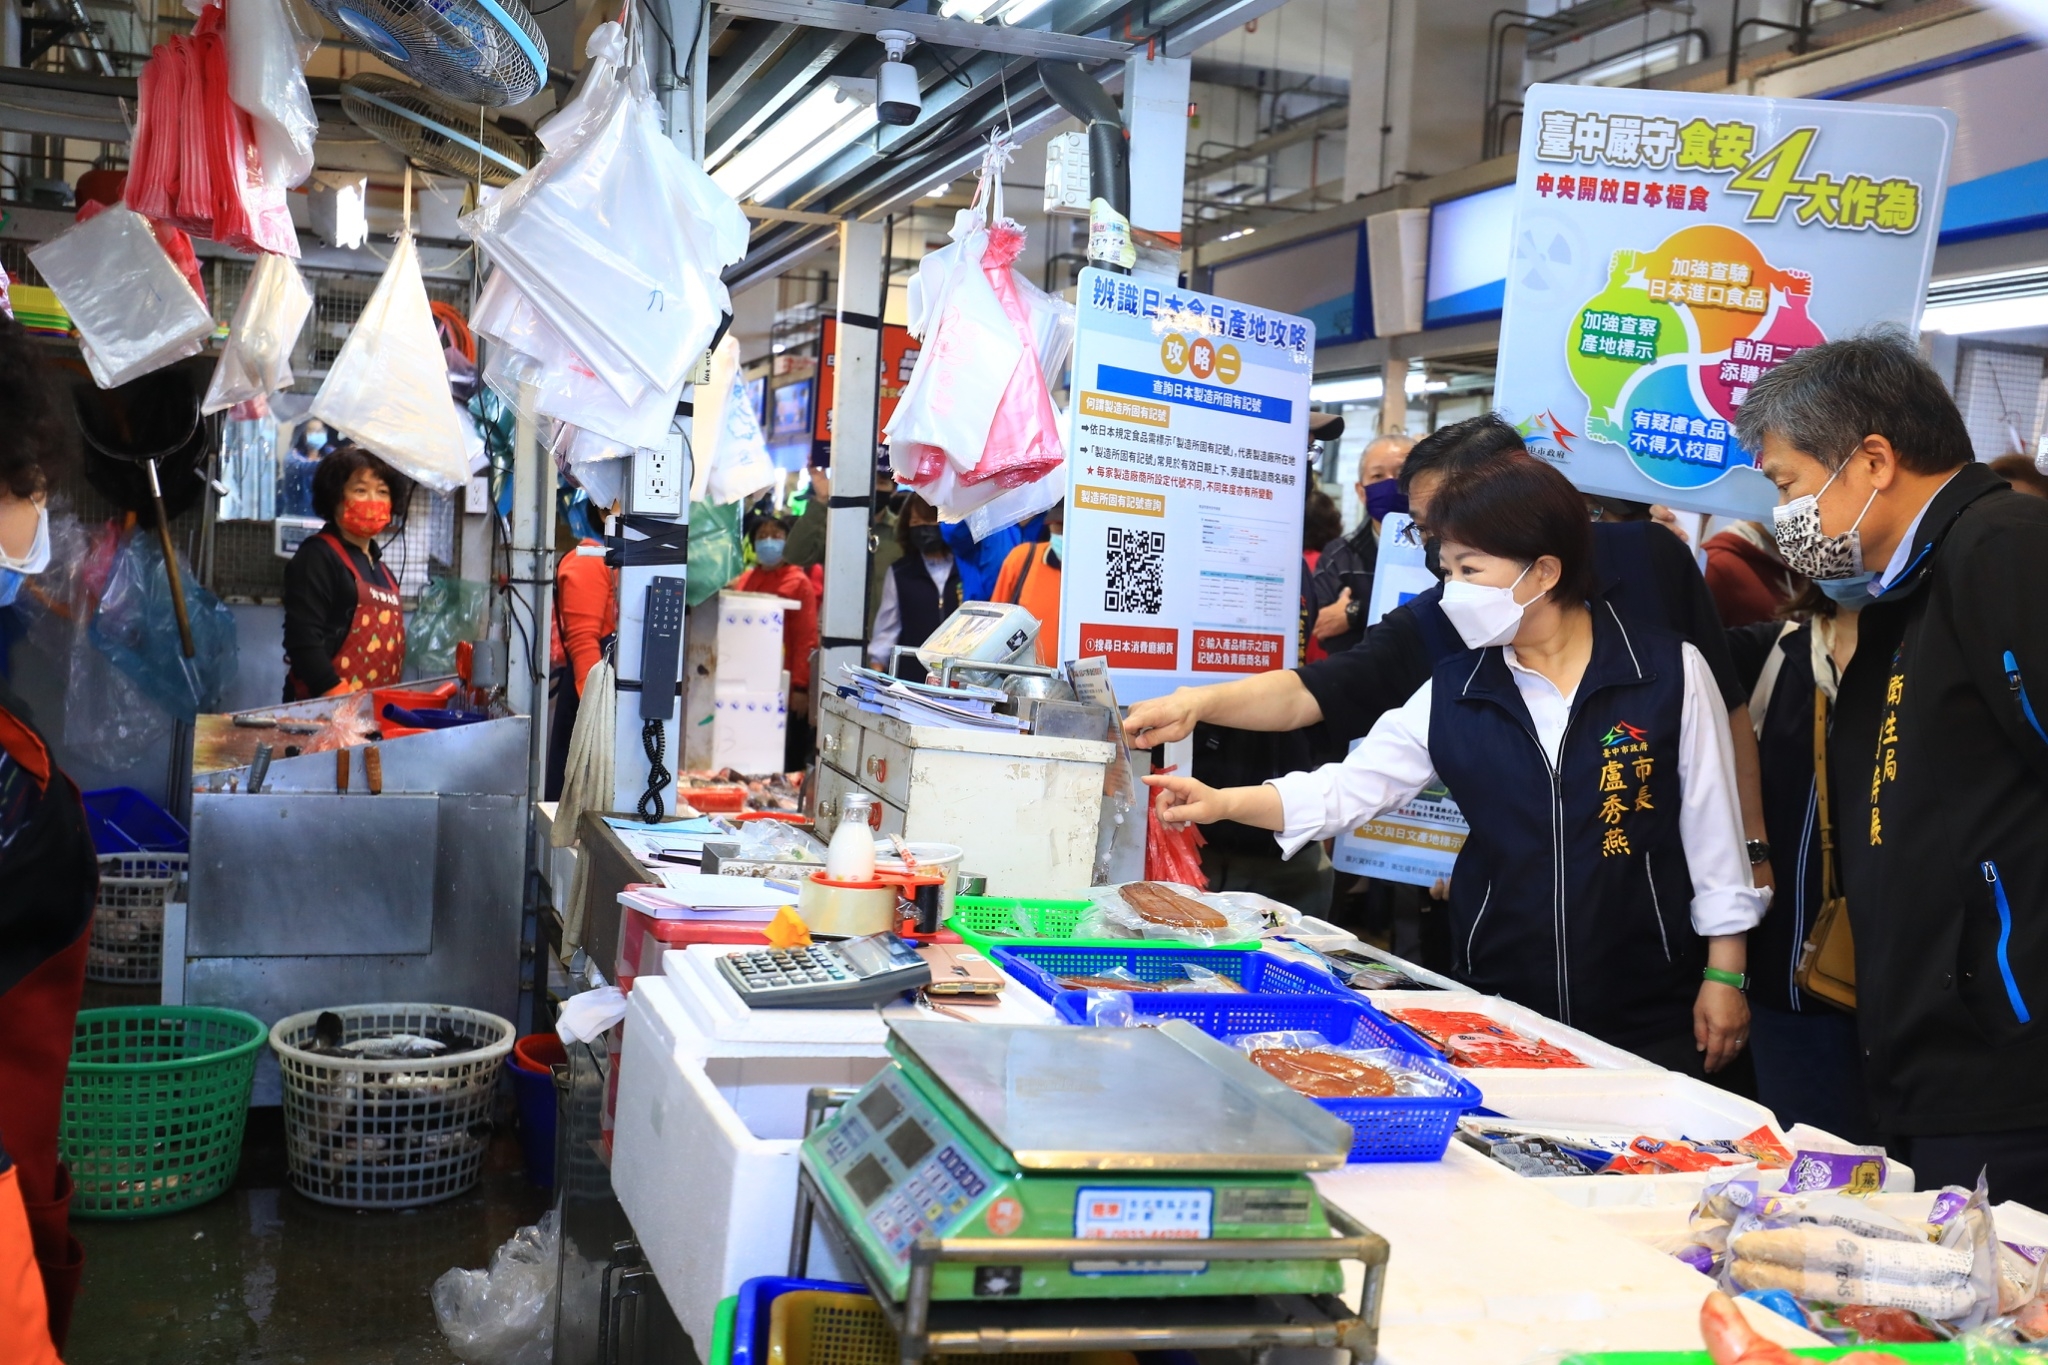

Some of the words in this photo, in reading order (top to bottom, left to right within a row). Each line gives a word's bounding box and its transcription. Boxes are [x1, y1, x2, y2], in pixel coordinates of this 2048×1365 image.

[1538, 110, 1921, 231] 臺中嚴守食安4大作為
[1536, 172, 1710, 212] 中央開放日本福食
[1669, 258, 1749, 284] 加強查驗
[1649, 279, 1765, 309] 日本進口食品
[1583, 311, 1658, 337] 加強查察
[1165, 341, 1236, 375] 攻略二
[1580, 334, 1654, 360] 產地標示
[1732, 340, 1811, 363] 動用二
[1719, 362, 1774, 384] 添購
[1086, 397, 1167, 423] 何謂製造所固有記號
[1152, 380, 1262, 413] 查詢日本製造所固有記號
[1633, 410, 1726, 441] 有疑慮食品
[1630, 432, 1723, 463] 不得入校園
[1081, 490, 1161, 512] 製造所固有記號查詢
[1882, 674, 1904, 782] 衛生局
[1603, 742, 1649, 758] 臺中市政府
[1632, 755, 1655, 812] 市長
[1598, 760, 1631, 858] 盧秀燕
[1362, 823, 1466, 849] 中文與日文產地標示
